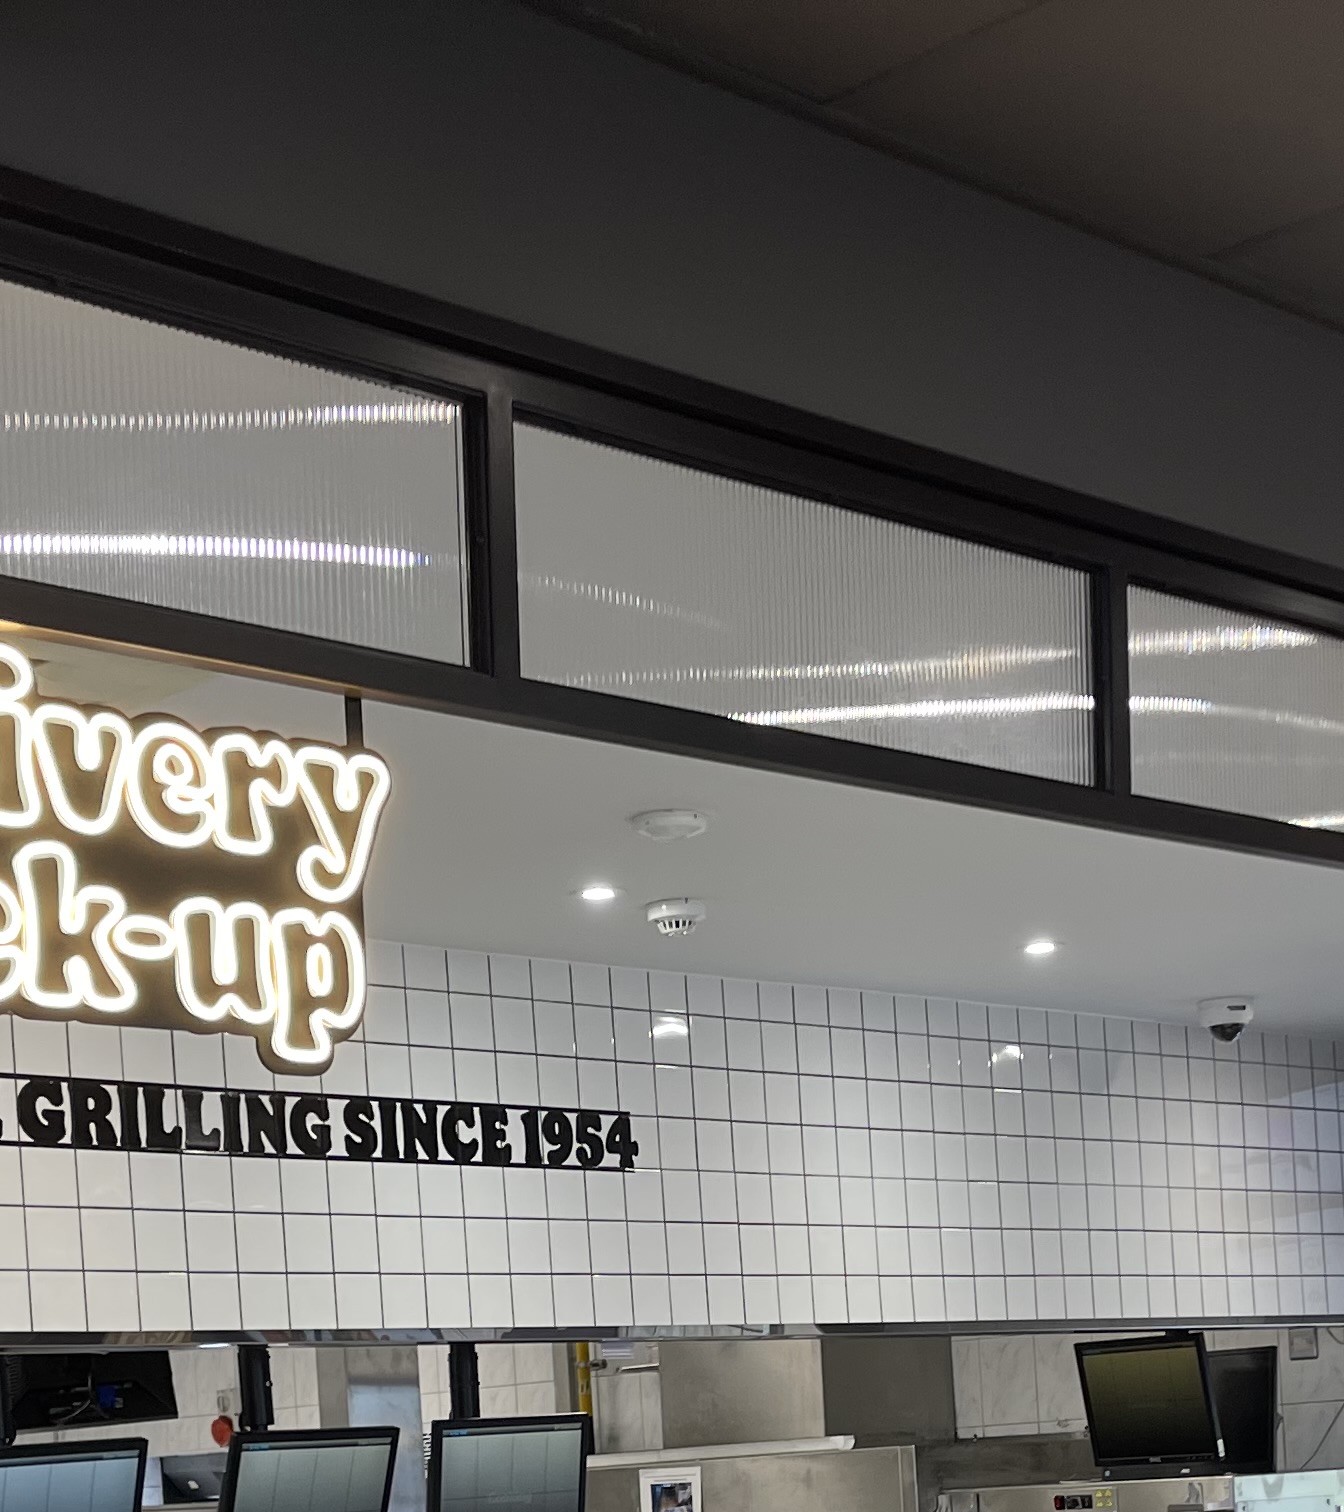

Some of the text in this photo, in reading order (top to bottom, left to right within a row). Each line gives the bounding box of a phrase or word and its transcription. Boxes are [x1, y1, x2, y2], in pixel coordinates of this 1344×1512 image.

[17, 1077, 331, 1160] GRILLING
[344, 1097, 511, 1166] SINCE
[521, 1111, 638, 1170] 1954
